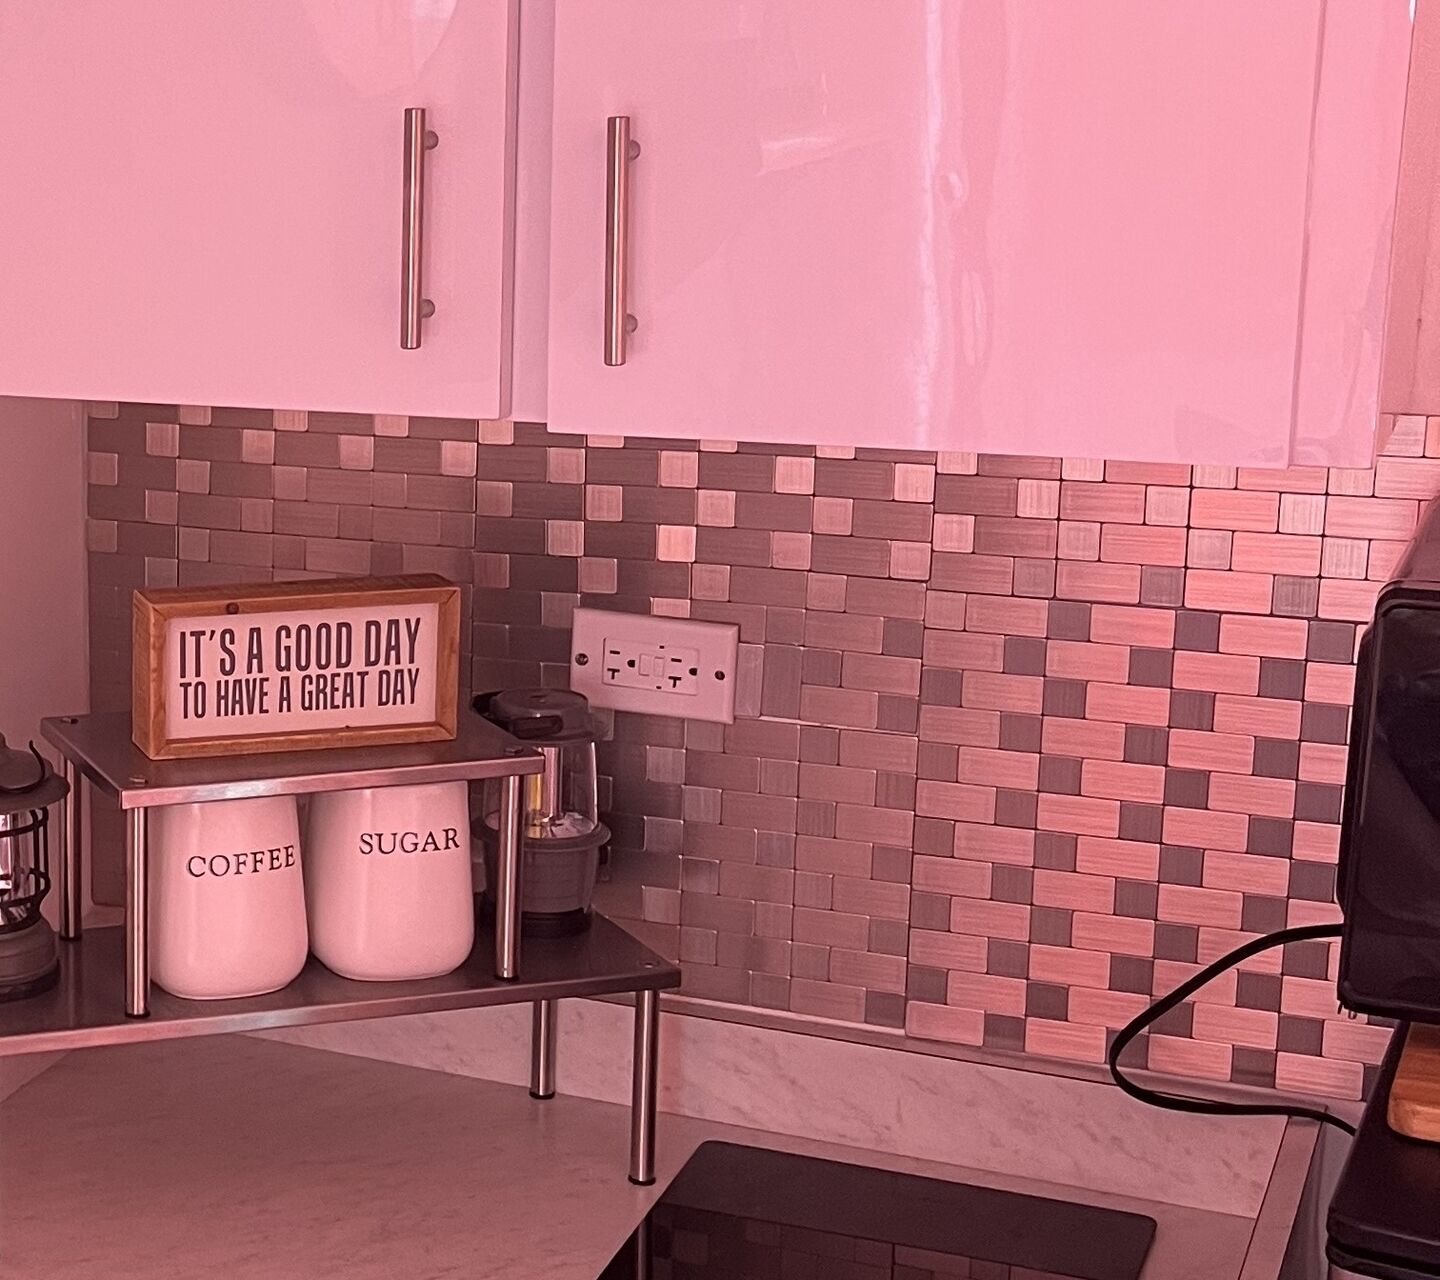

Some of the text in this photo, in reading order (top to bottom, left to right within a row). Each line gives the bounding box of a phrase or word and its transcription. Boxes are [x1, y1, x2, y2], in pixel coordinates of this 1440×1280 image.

[179, 617, 421, 679] IT'S A GOOD DAY
[179, 668, 420, 719] TO HAVE A GREAT DAY
[186, 845, 296, 878] COFFEE
[359, 828, 460, 855] SUGAR
